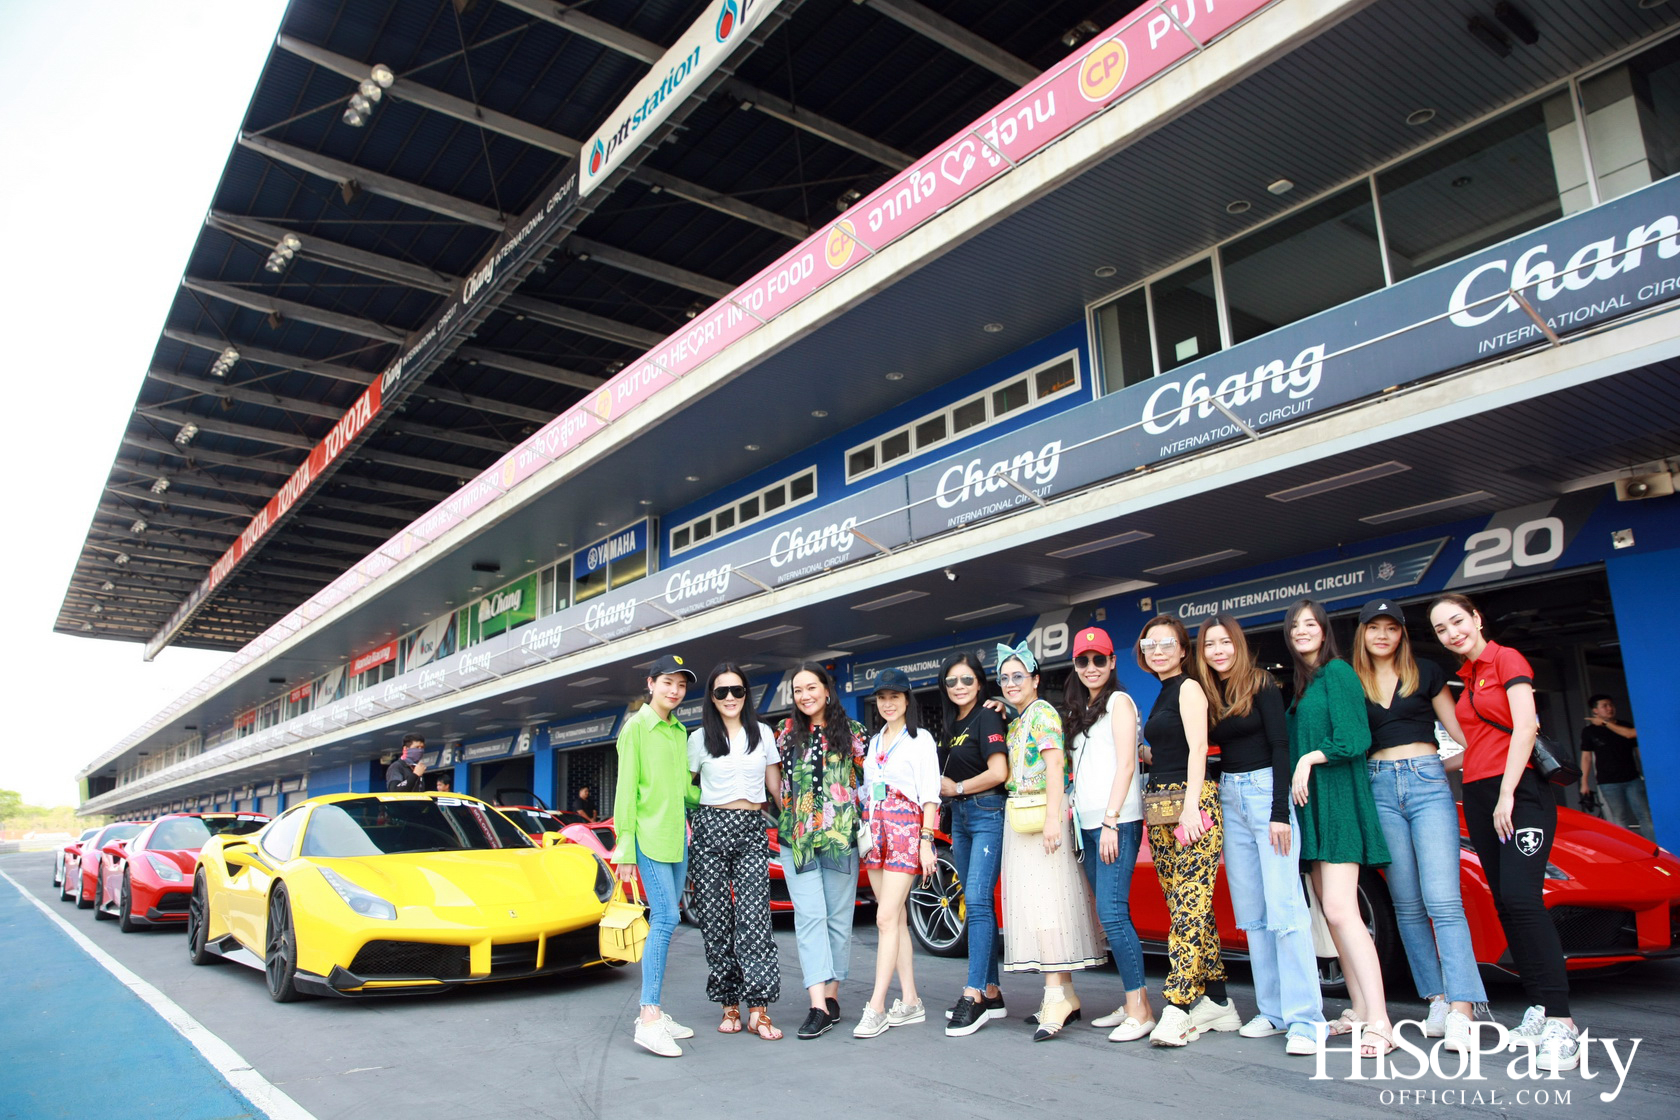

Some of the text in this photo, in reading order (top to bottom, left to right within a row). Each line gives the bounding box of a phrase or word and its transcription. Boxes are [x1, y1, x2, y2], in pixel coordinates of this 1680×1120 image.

[1148, 0, 1214, 50] PU
[1085, 51, 1121, 88] CP
[463, 173, 577, 305] Chang INTERNATIONAL CIRCUIT
[829, 232, 851, 258] CP
[617, 377, 642, 404] PUT
[642, 354, 668, 386] OUR
[727, 287, 764, 329] INTO
[767, 253, 815, 303] FOOD
[1478, 293, 1632, 354] INTERNATIONAL
[1142, 343, 1326, 435] Chang
[325, 390, 371, 465] TOYOTA
[1258, 398, 1315, 425] CIRCUIT
[277, 459, 311, 518] TOYOTA
[936, 439, 1062, 509] Chang
[241, 508, 269, 556] TOYOTA
[947, 498, 1013, 527] INTERNATIONAL
[598, 530, 635, 564] YAMAHA
[769, 516, 857, 568] Chang
[1463, 517, 1564, 579] 20
[665, 562, 732, 605] Chang
[777, 553, 850, 583] INTERNATIONAL CIRCUIT
[491, 589, 522, 617] Chang
[585, 598, 637, 632] Chang
[1178, 570, 1365, 619] Chang INTERNATIONAL CIRCUIT
[521, 625, 563, 655] Chang
[1026, 622, 1069, 660] 19
[458, 651, 492, 676] Chang
[518, 733, 530, 752] 16
